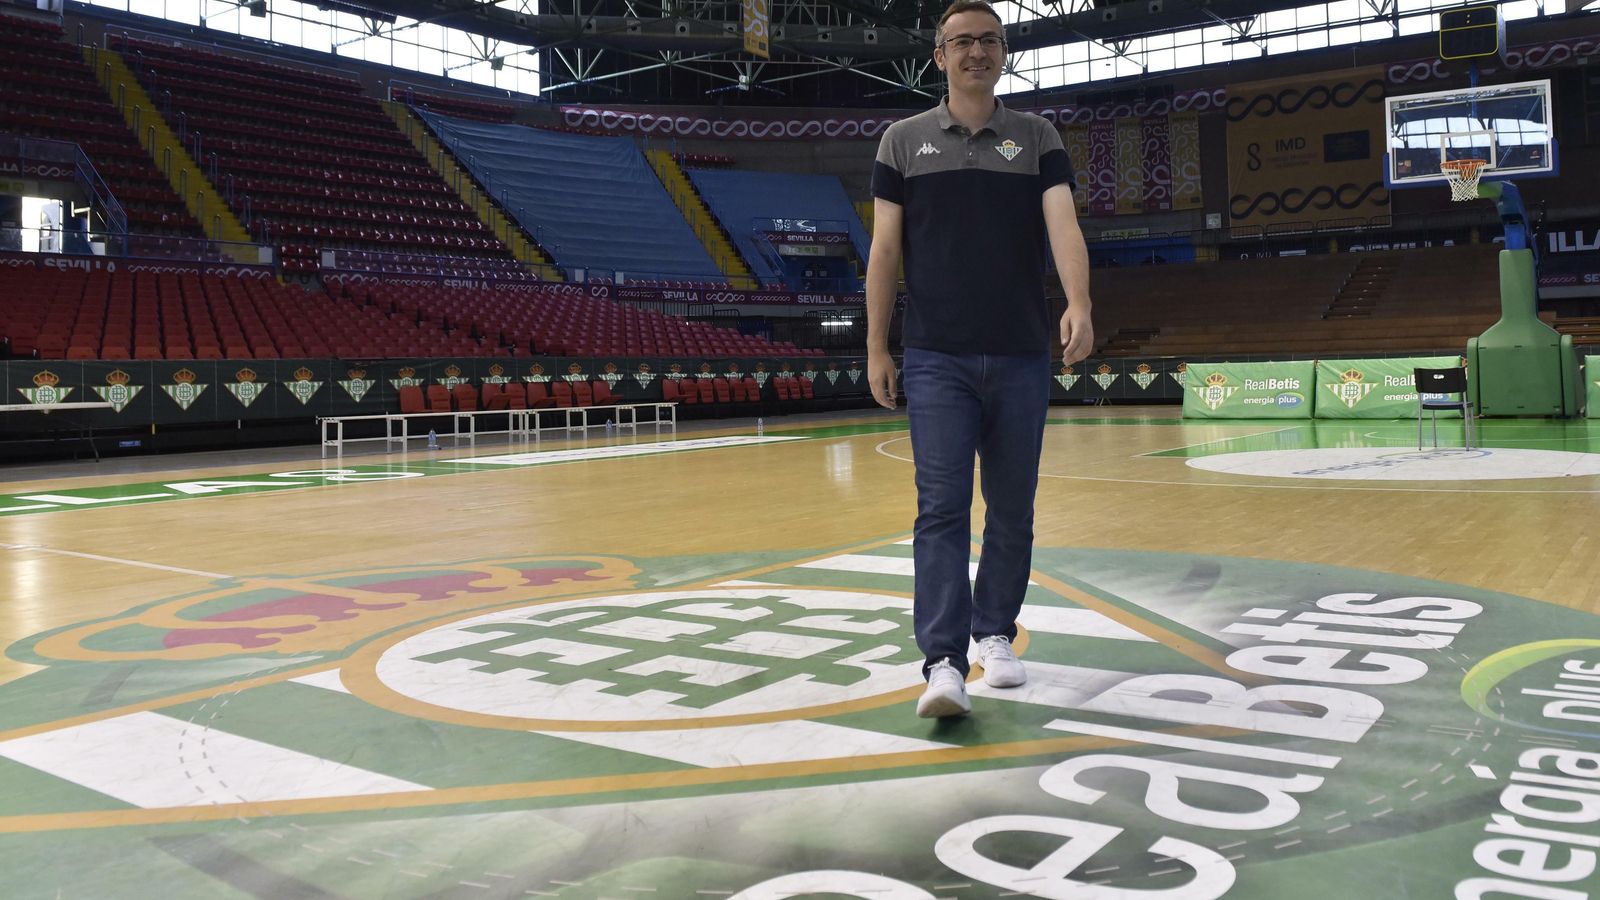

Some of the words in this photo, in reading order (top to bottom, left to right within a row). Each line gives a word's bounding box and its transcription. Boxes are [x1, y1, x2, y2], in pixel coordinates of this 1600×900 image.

[1275, 136, 1306, 153] IMD
[787, 234, 814, 242] SEVILLA
[797, 294, 836, 304] SEVILLA
[1244, 377, 1300, 391] RealBetis
[1278, 395, 1297, 406] plus
